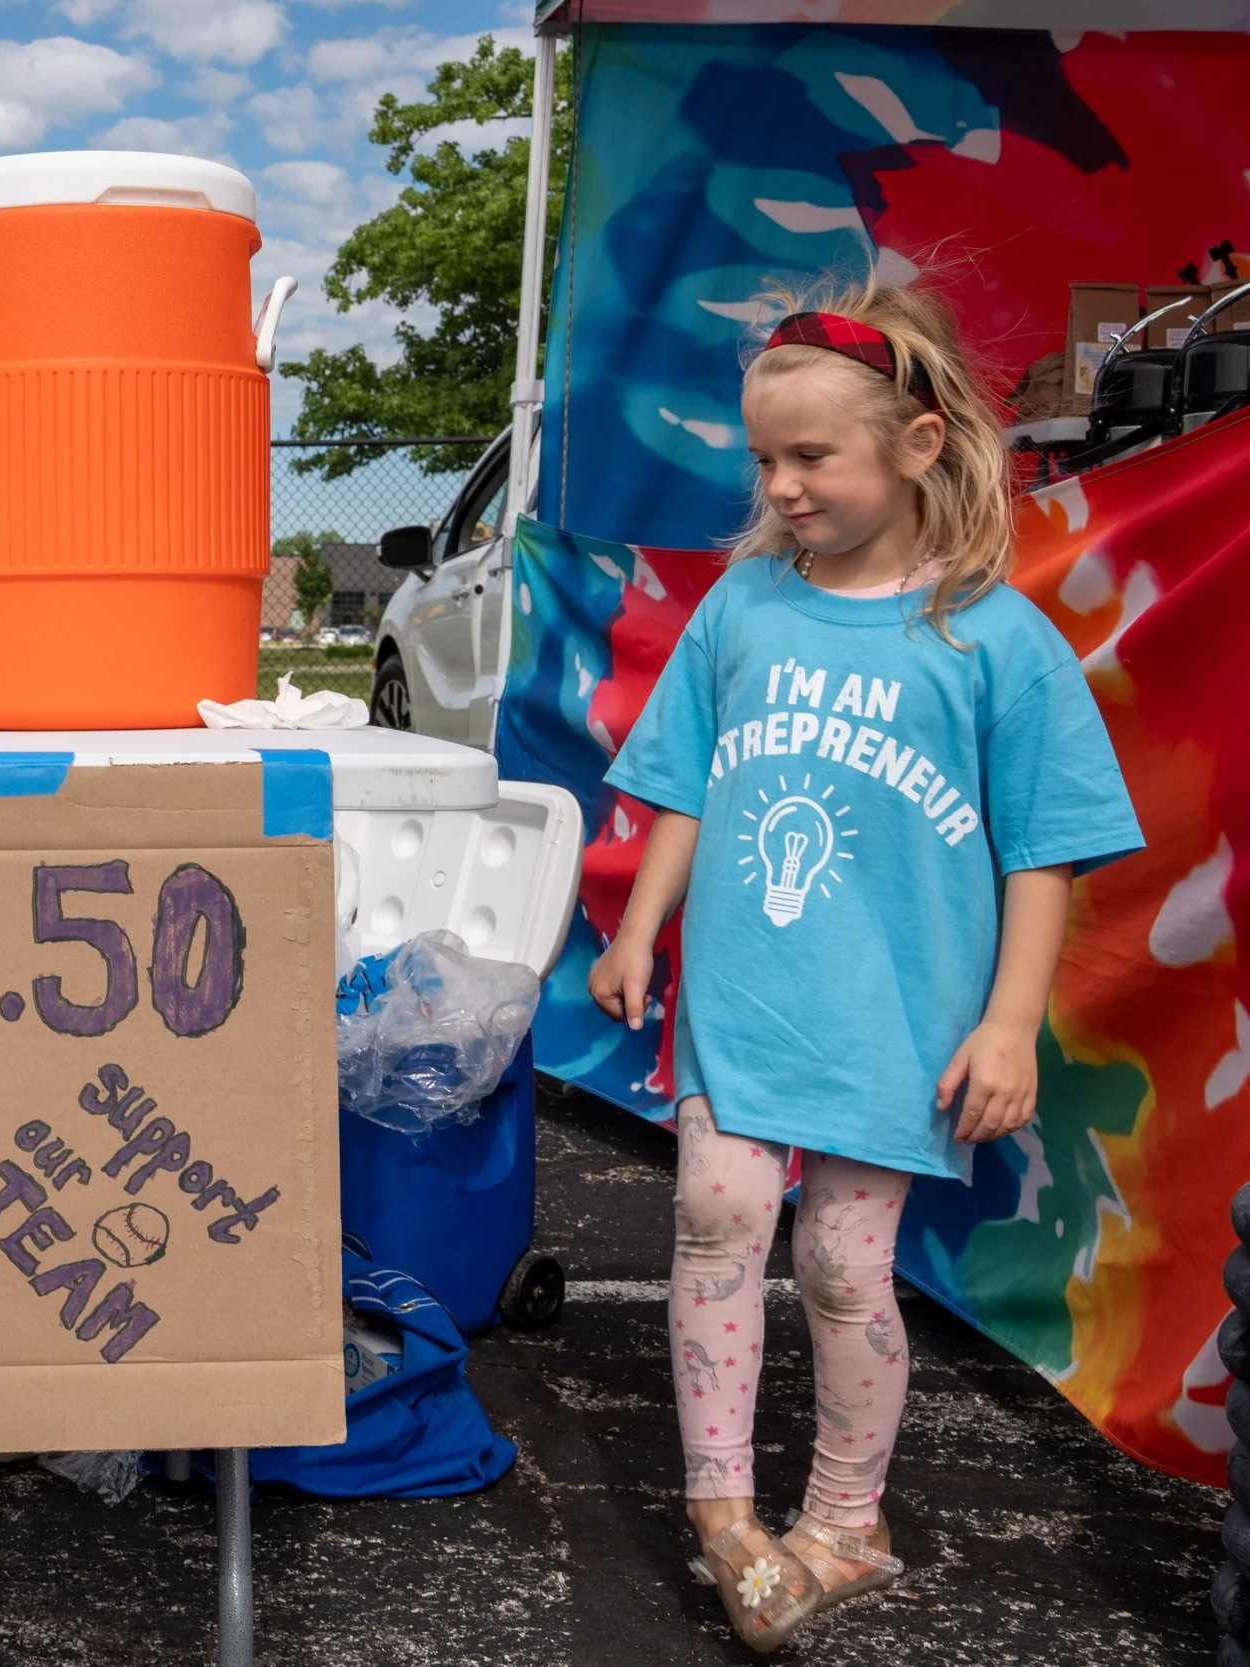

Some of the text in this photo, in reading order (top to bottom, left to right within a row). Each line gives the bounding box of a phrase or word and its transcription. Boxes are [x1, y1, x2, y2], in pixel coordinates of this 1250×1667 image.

[765, 657, 901, 722] I'M AN
[707, 711, 979, 848] TREPRENEUR
[15, 1119, 93, 1194] our
[78, 1063, 280, 1246] support
